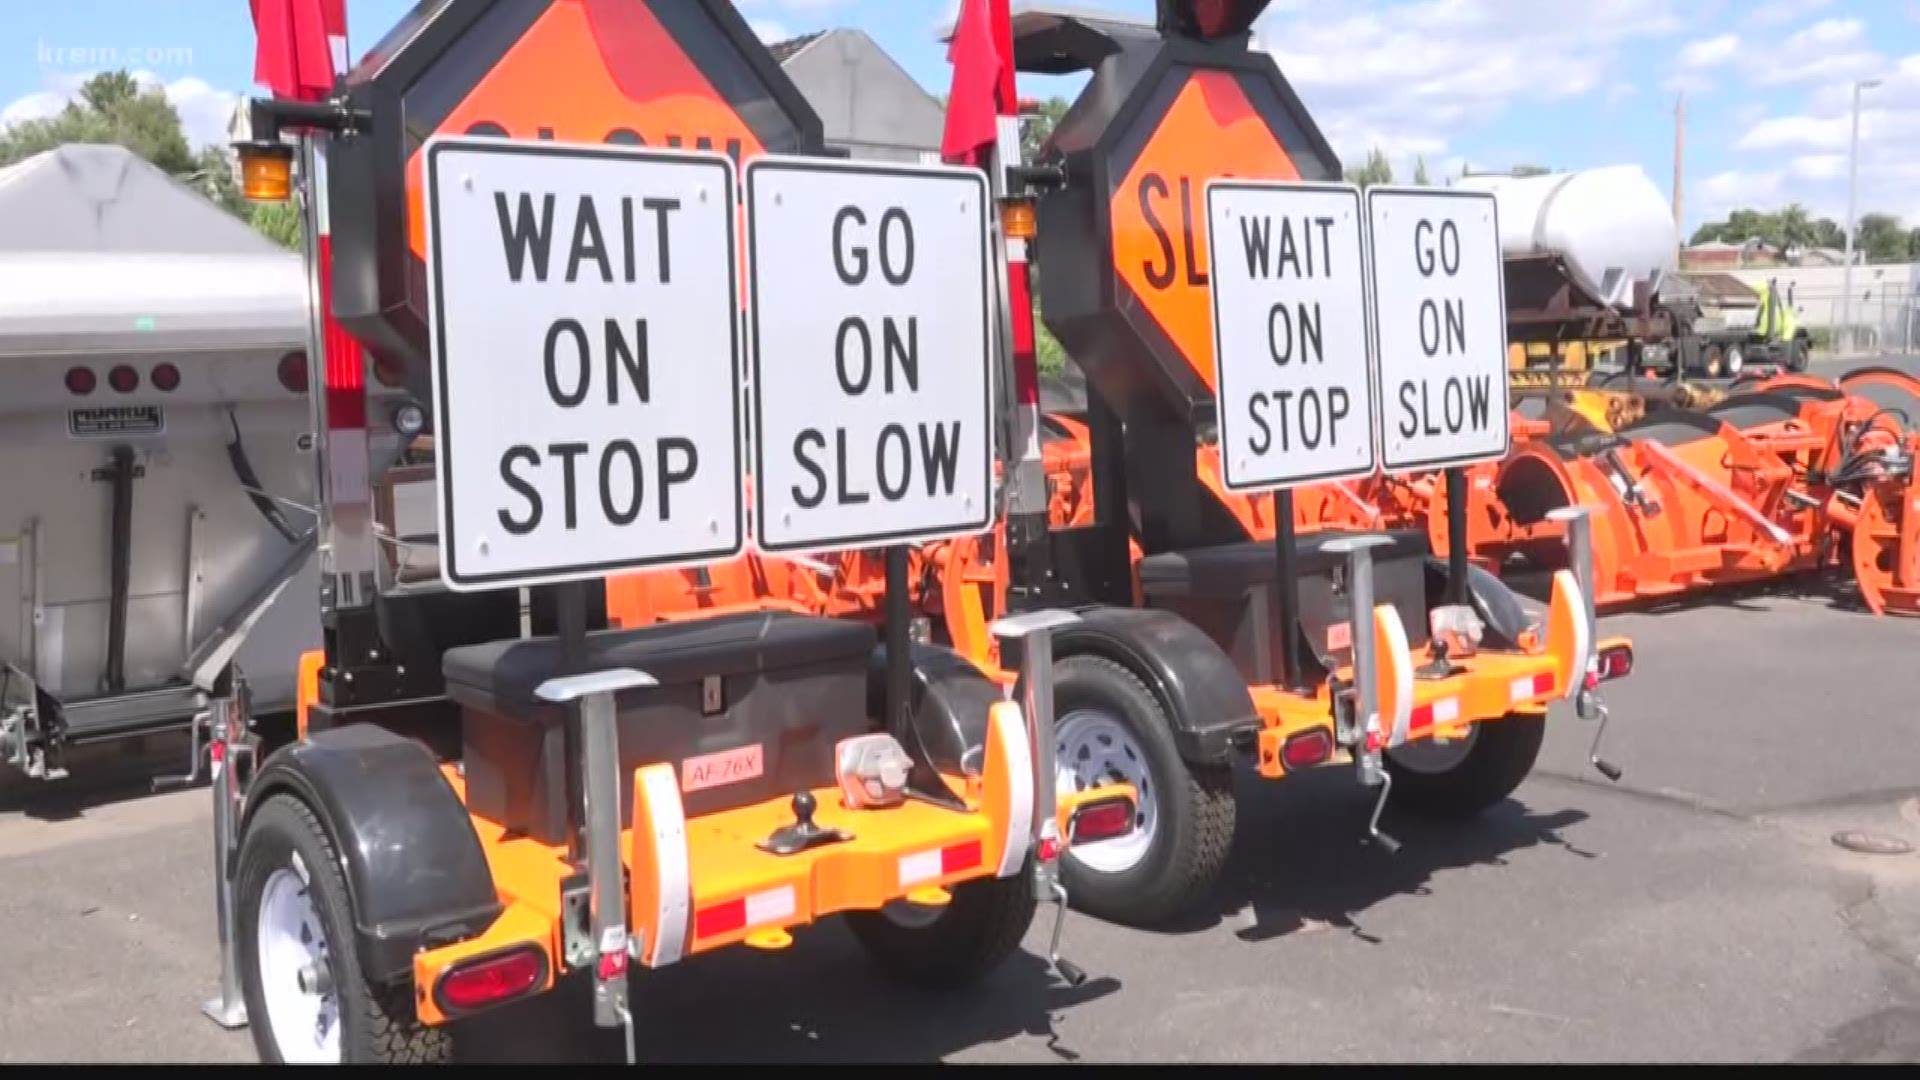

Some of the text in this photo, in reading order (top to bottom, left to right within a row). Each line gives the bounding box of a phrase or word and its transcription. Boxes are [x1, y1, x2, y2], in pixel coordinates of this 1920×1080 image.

[494, 191, 681, 284] WAIT
[832, 206, 915, 286] GO
[1240, 216, 1334, 278] WAIT
[1415, 219, 1460, 277] GO
[543, 318, 650, 408] ON
[835, 316, 919, 396] ON
[1268, 302, 1323, 366] ON
[1419, 299, 1465, 356] ON
[1248, 386, 1350, 456] STOP
[1399, 376, 1490, 439] SLOW
[497, 437, 699, 536] STOP
[791, 420, 961, 510] SLOW
